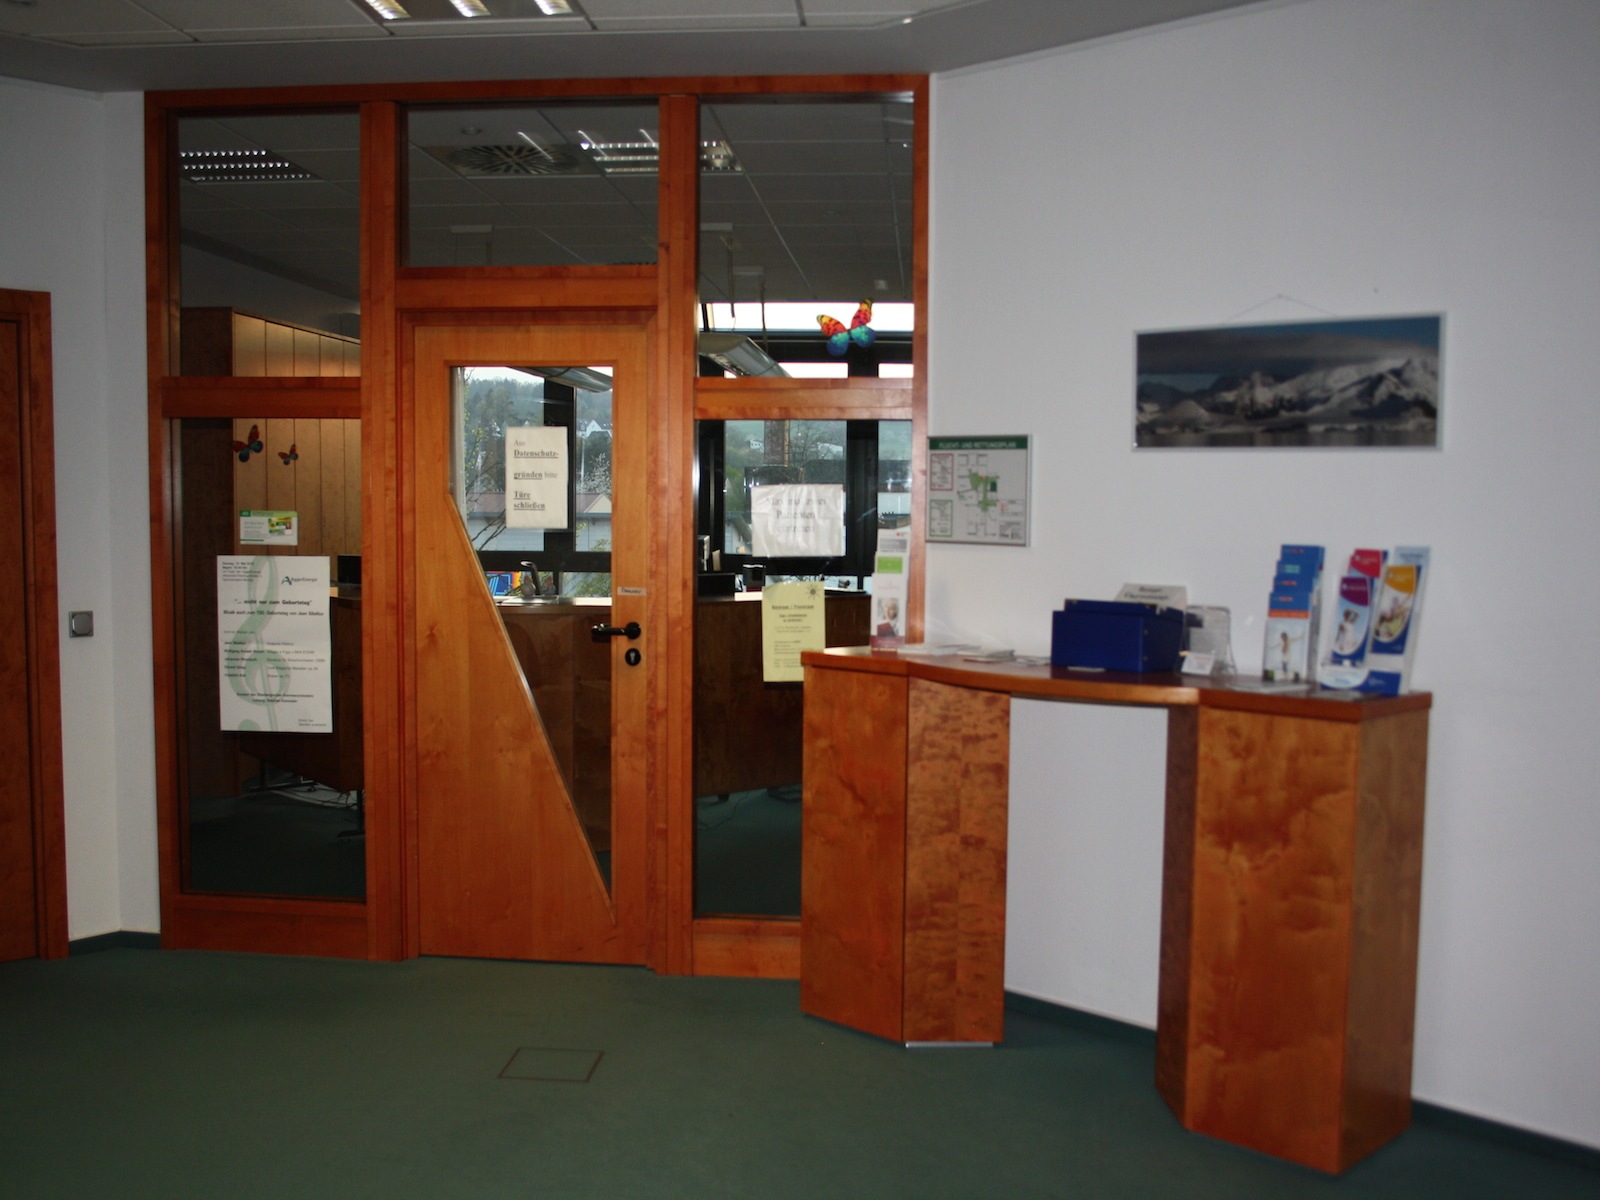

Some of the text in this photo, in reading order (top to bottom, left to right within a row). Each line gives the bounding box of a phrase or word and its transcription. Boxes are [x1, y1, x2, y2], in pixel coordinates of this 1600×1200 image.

[513, 449, 559, 458] Datenschutz-
[513, 471, 543, 480] gründen
[513, 490, 531, 499] Türe
[513, 502, 546, 510] schließen
